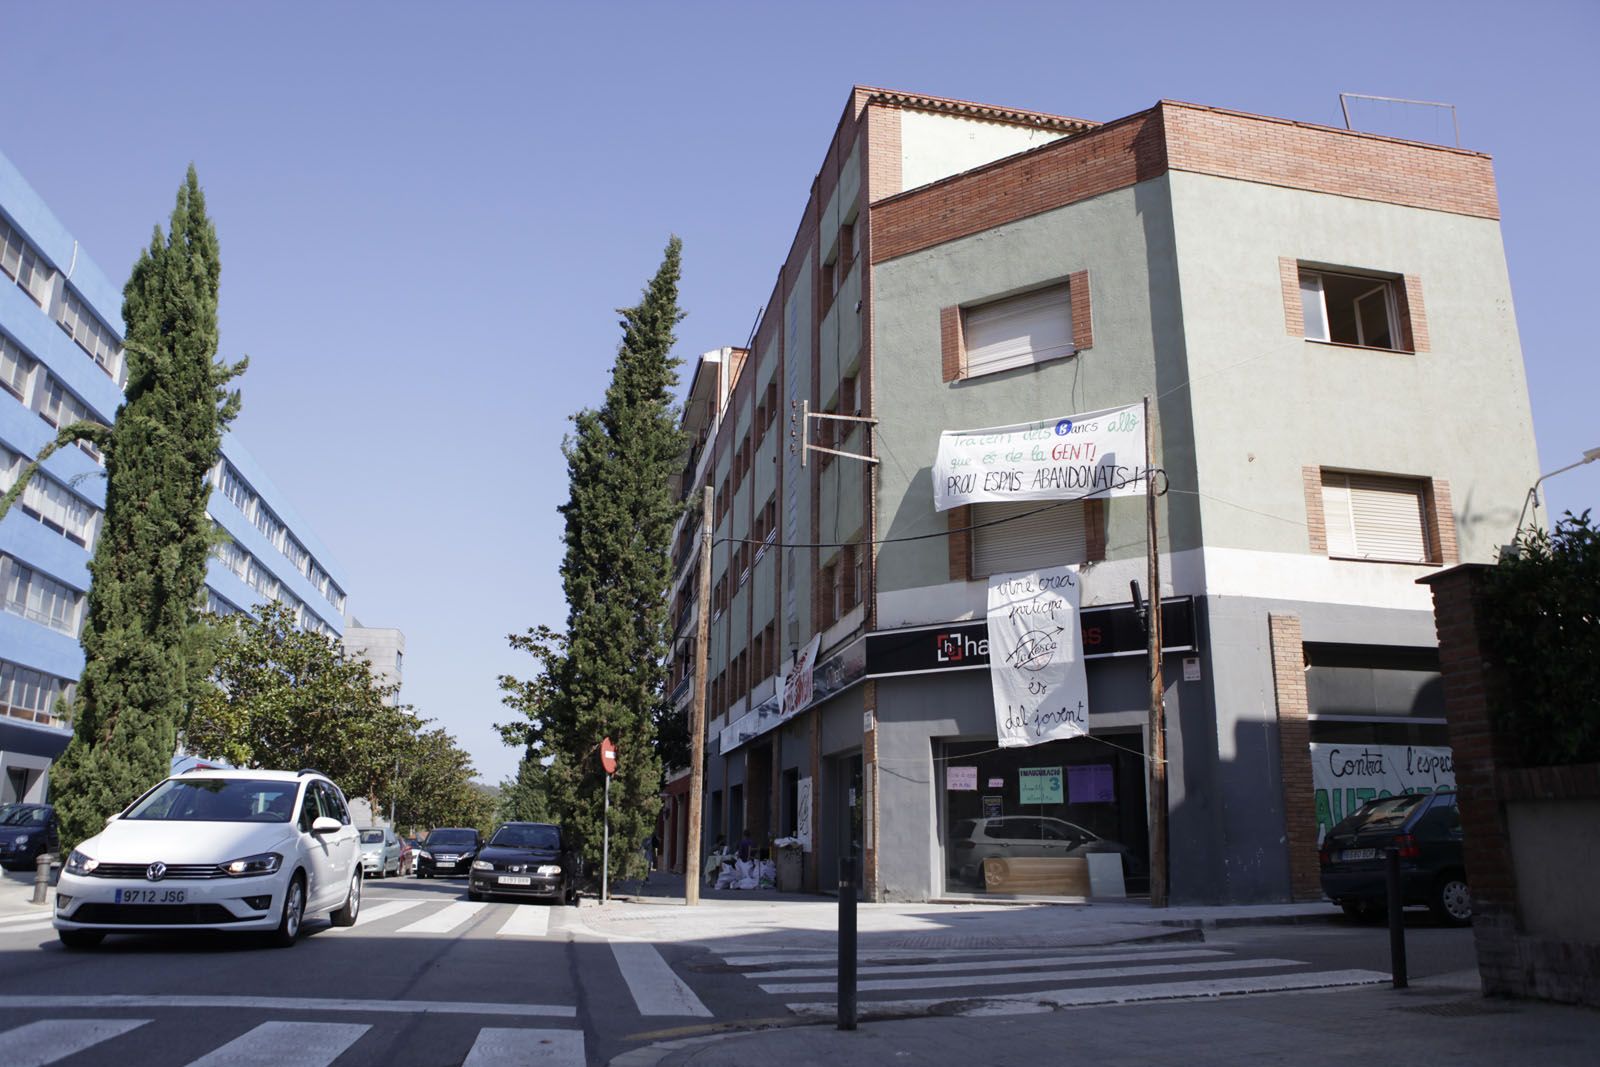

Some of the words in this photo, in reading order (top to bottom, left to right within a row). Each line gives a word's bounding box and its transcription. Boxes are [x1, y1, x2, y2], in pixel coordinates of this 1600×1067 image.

[950, 458, 972, 473] que
[1005, 448, 1024, 462] de
[1031, 444, 1047, 461] la
[1051, 442, 1097, 462] GENT!
[947, 473, 977, 496] PROU
[1005, 705, 1029, 730] del
[1034, 701, 1085, 737] jovent
[1329, 748, 1387, 778] Contra
[1049, 776, 1061, 792] 3
[123, 890, 157, 903] 9712
[160, 890, 185, 903] JSG
